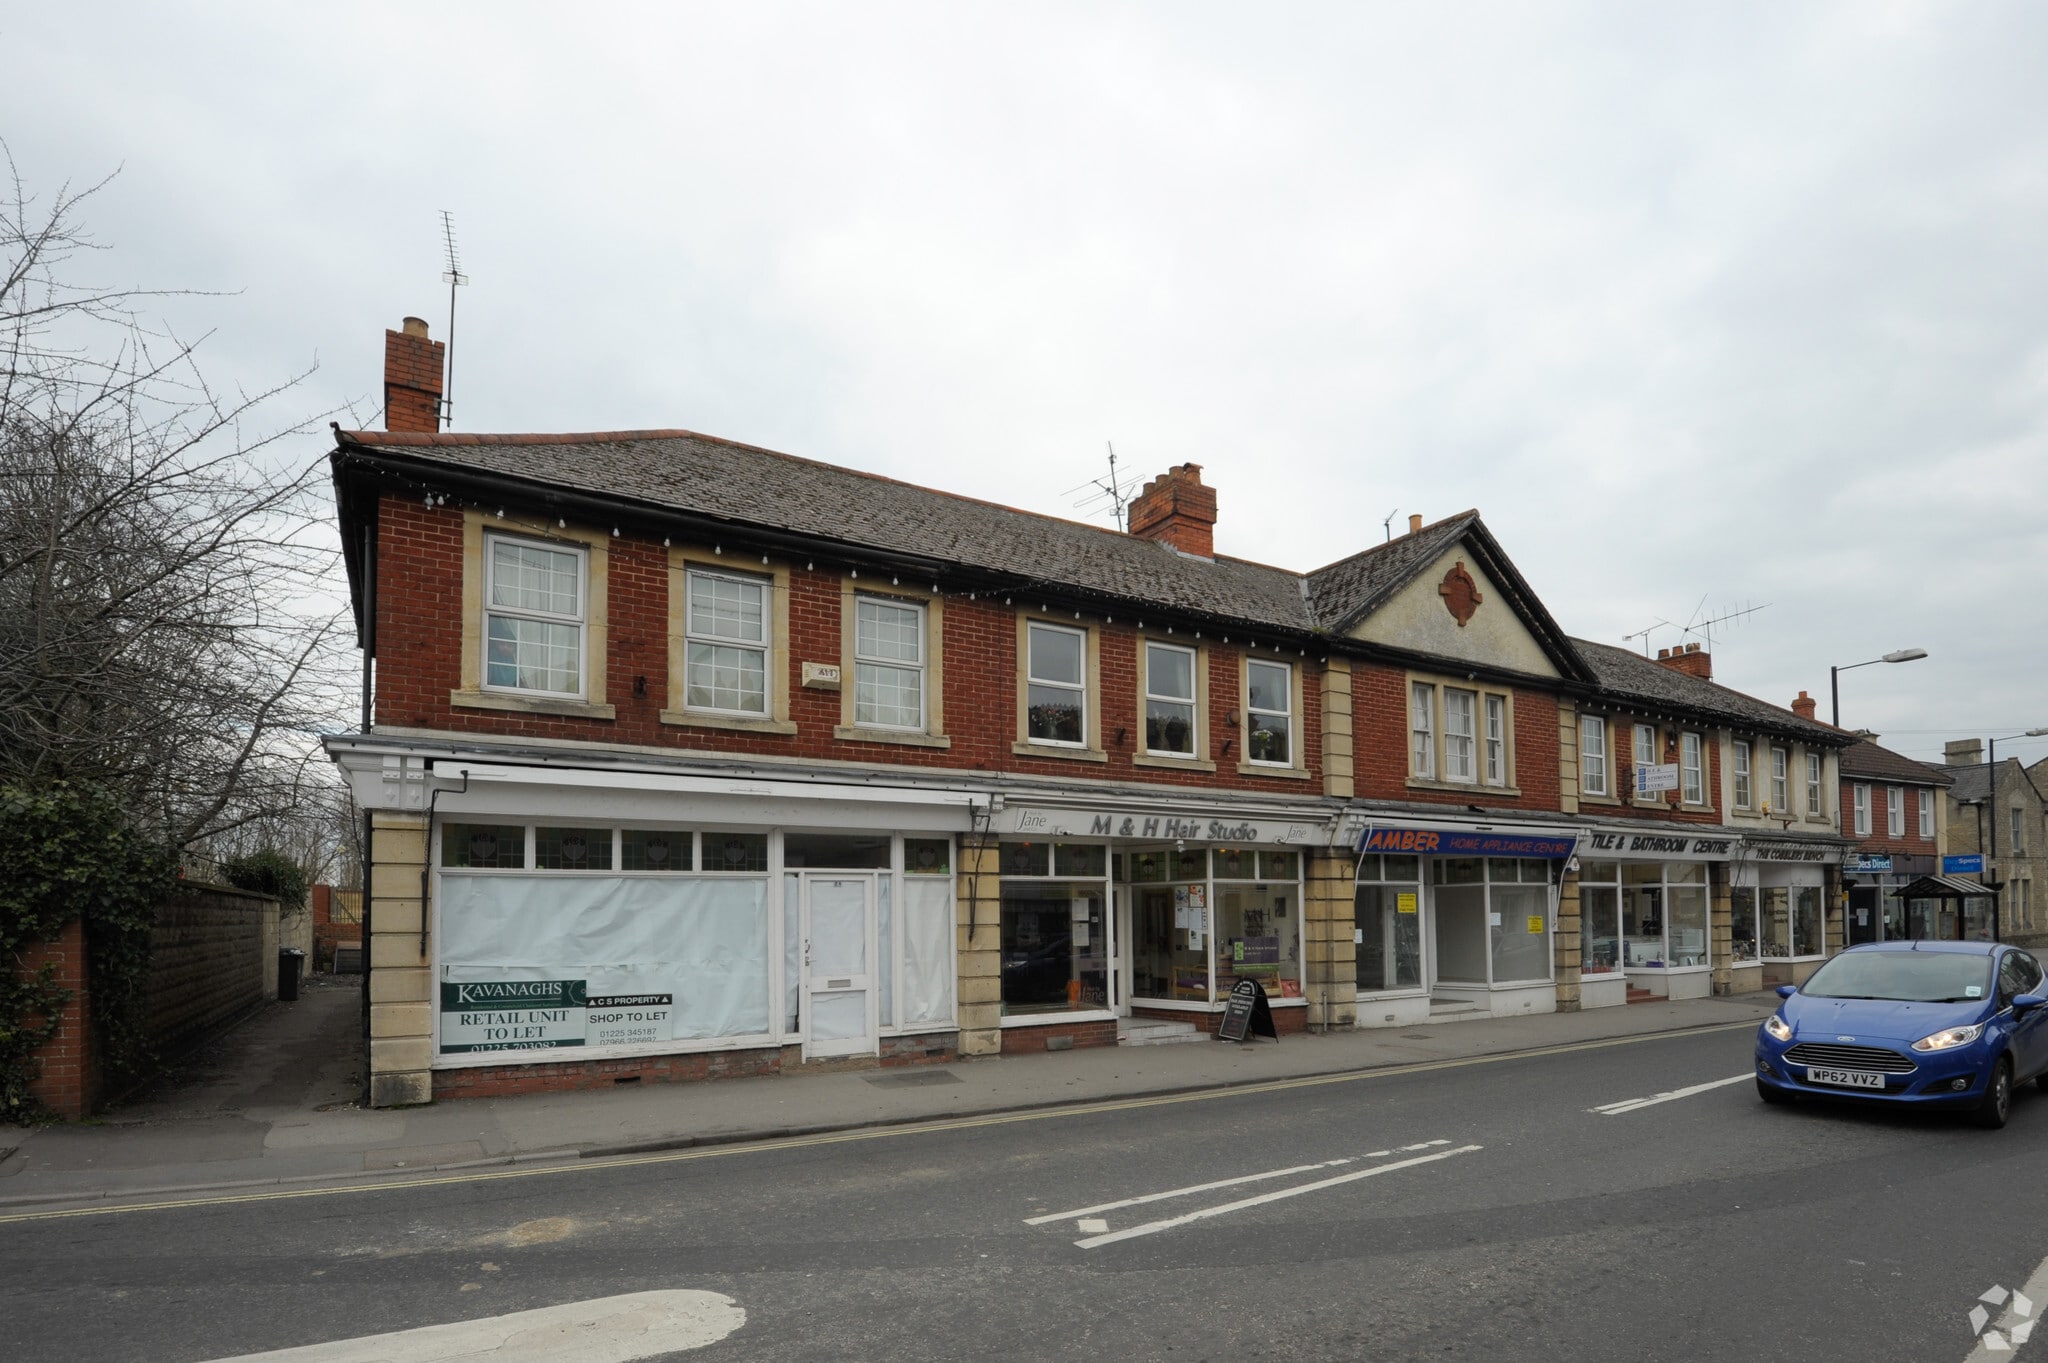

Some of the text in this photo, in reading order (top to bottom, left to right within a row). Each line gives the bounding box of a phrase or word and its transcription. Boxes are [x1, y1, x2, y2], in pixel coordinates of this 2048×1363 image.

[1017, 810, 1046, 831] Jane
[1090, 815, 1258, 841] M & H Hair Studio
[1285, 824, 1307, 841] Jane
[1368, 831, 1568, 854] AMBER HOME APPLIANCE CENTRE
[1591, 833, 1731, 854] TILE & BATHROOM CENTRE
[1756, 848, 1770, 859] THE
[1872, 858, 1890, 869] Direct
[457, 982, 563, 1004] KAVANAGHS
[614, 996, 660, 1005] PROPERTY
[460, 1010, 570, 1026] RETAIL UNIT
[589, 1011, 668, 1024] SHOP TO LET
[484, 1026, 547, 1040] TO LET
[600, 1028, 657, 1038] 01225 345187
[1813, 1070, 1879, 1086] WP62 VVZ
